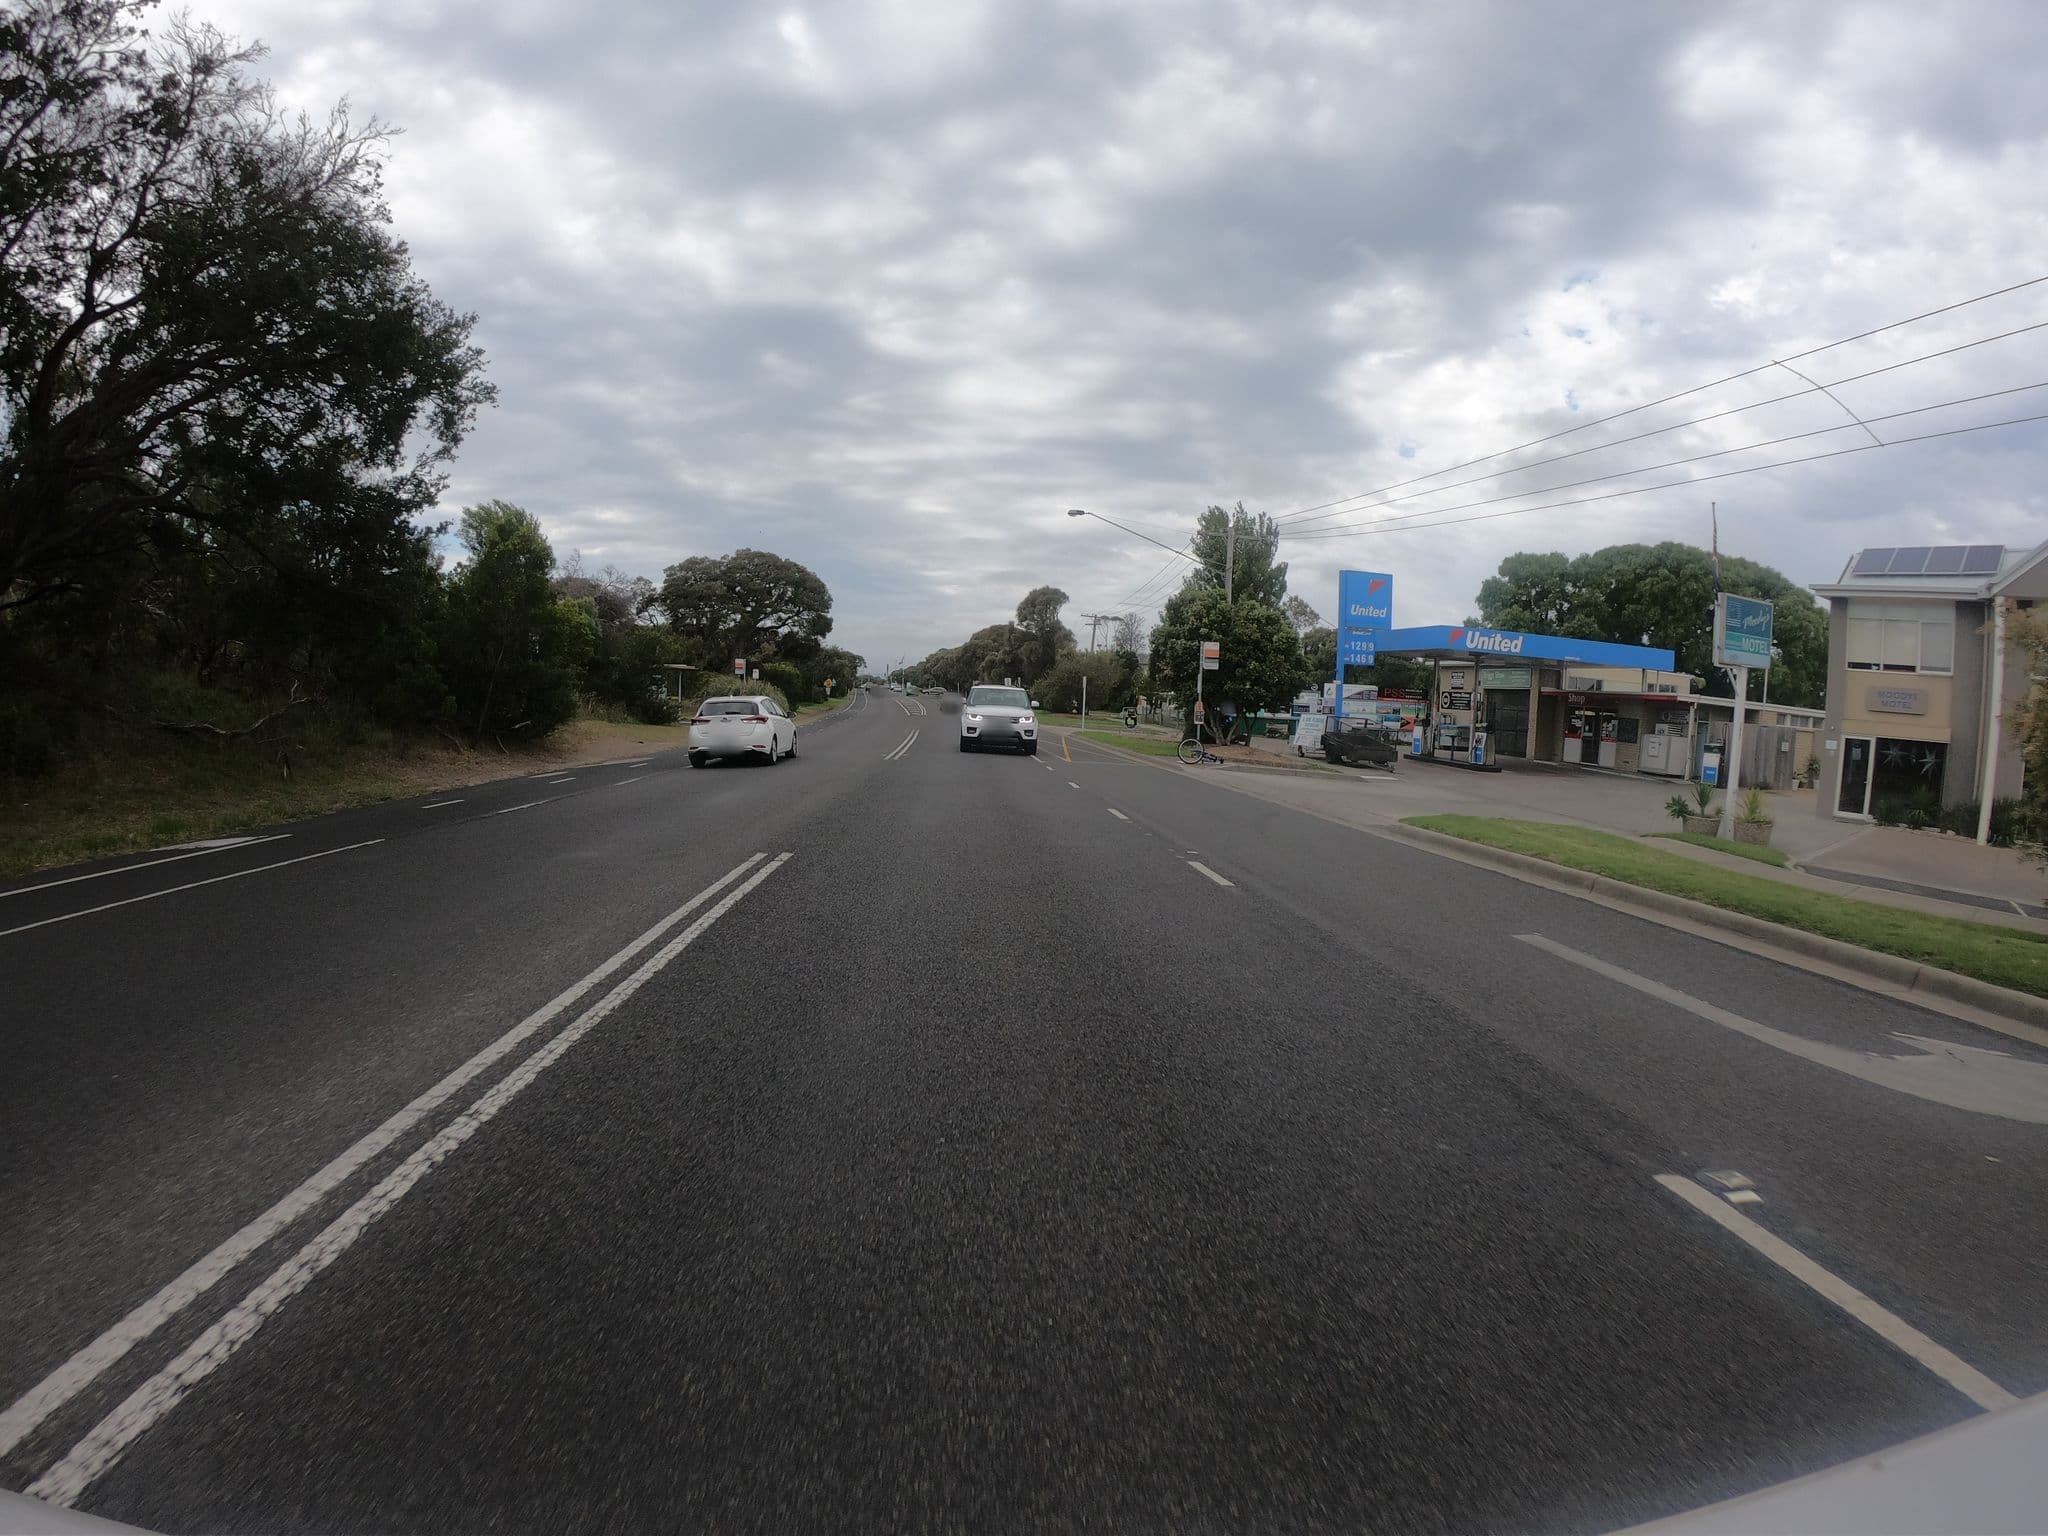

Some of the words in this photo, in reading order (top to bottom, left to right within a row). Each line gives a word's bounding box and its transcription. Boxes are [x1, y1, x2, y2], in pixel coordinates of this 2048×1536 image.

[1351, 604, 1387, 618] United
[1466, 631, 1523, 653] United
[1742, 637, 1769, 654] MOTEL
[1568, 693, 1586, 704] Shop
